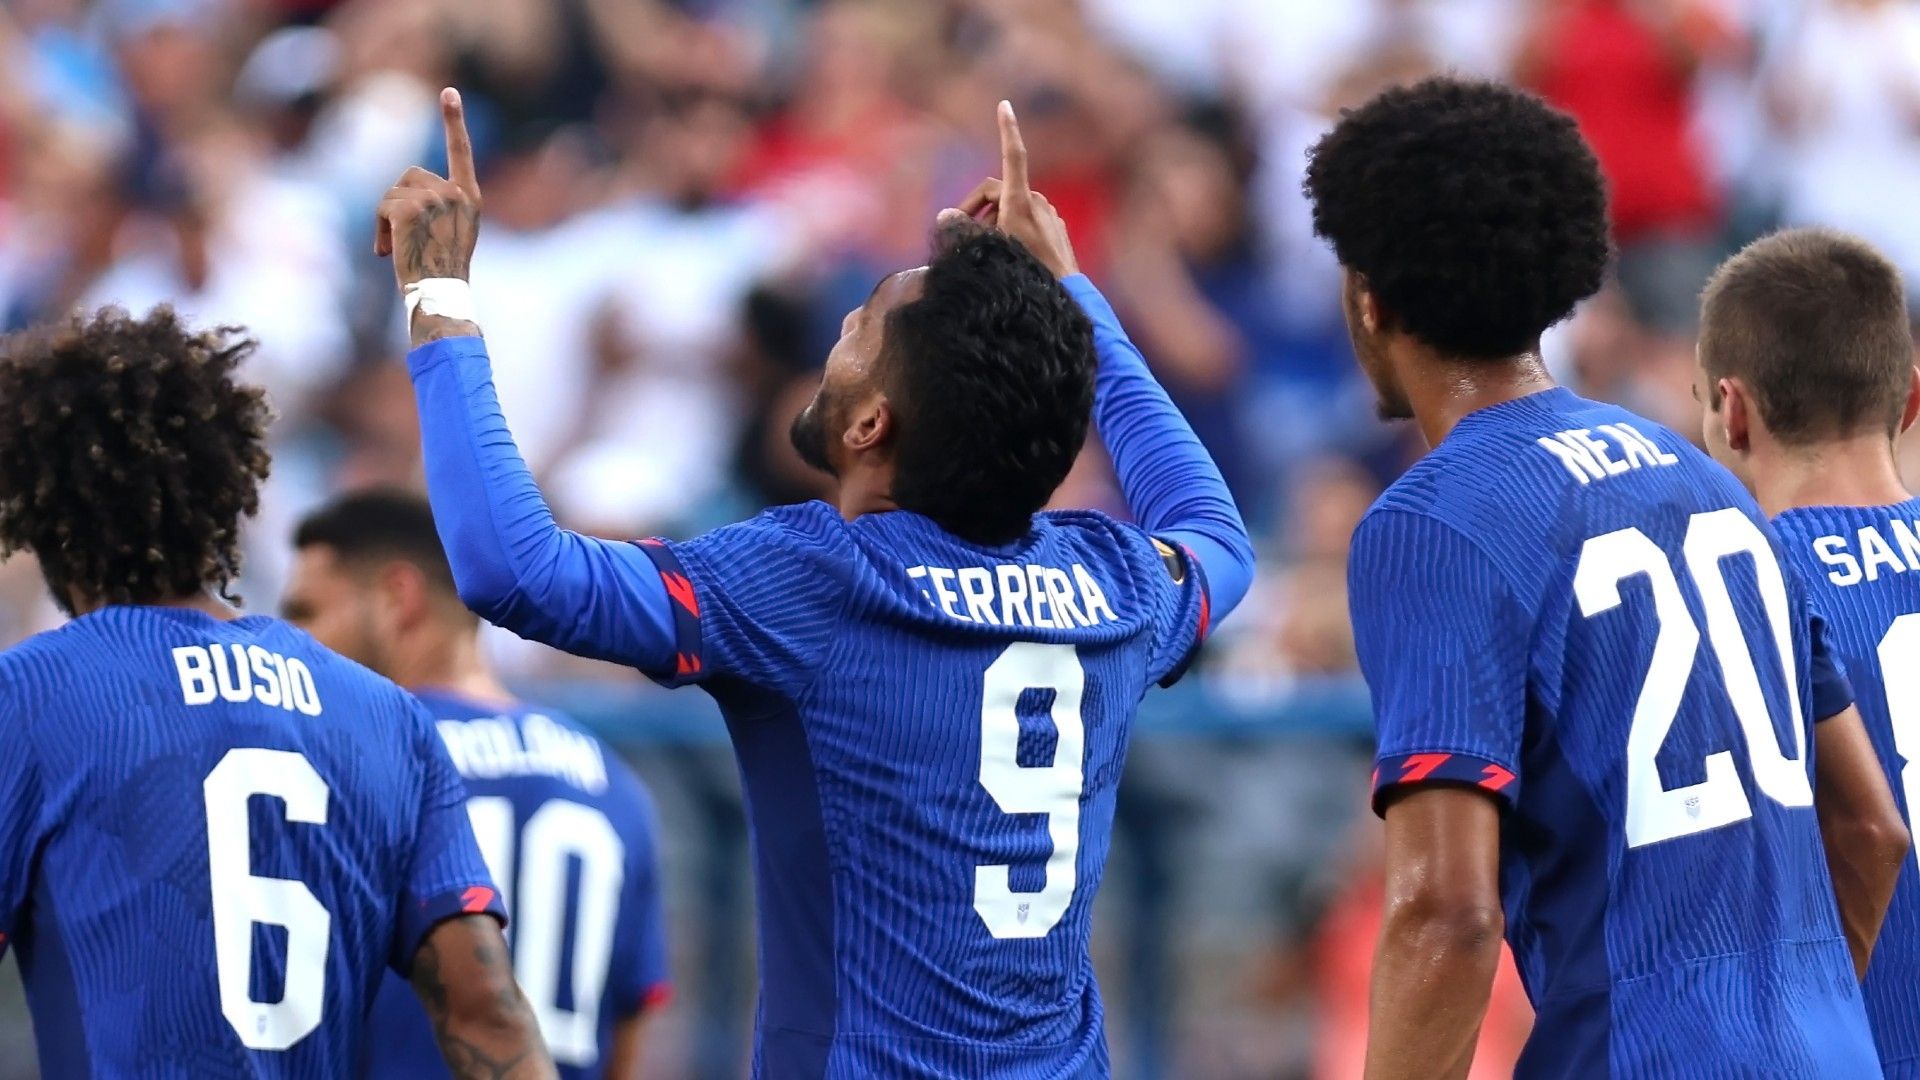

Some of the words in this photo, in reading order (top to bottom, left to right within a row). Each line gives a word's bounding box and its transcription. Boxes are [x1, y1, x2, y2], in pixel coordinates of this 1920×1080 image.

[1537, 422, 1676, 487] NEAL
[171, 645, 322, 717] BUSIO
[973, 641, 1086, 941] 9
[1573, 507, 1815, 849] 20
[203, 747, 331, 1051] 6
